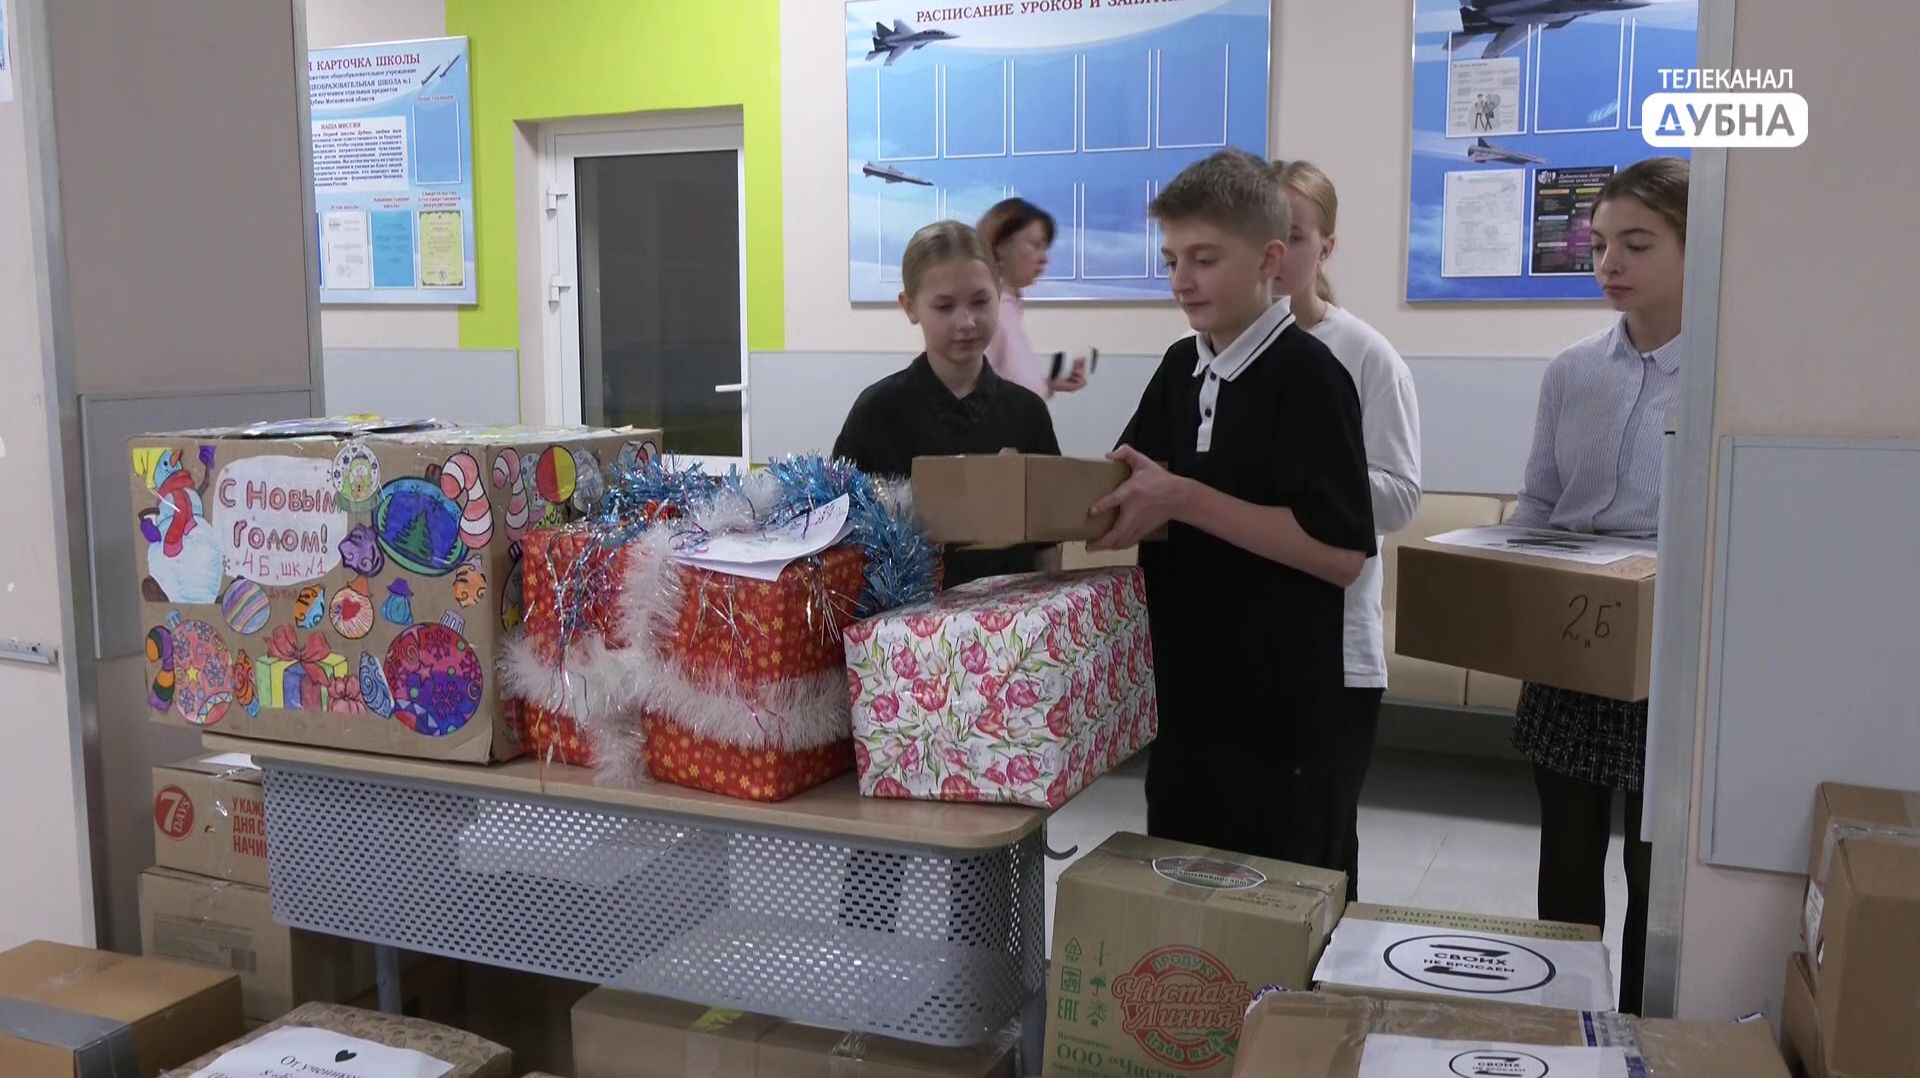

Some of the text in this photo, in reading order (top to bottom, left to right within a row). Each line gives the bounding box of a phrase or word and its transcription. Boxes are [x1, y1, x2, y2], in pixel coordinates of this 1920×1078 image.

[916, 3, 1014, 23] РАСПИСАНИЕ
[1020, 0, 1083, 14] УРОКОВ
[317, 57, 372, 71] КАРТОЧКА
[375, 53, 420, 67] ШКОЛЫ
[219, 478, 237, 508] С
[160, 791, 191, 833] 7 DAYS
[233, 815, 256, 835] ДНЯ
[1152, 953, 1220, 979] ПРОДУКТ
[1424, 958, 1515, 973] НЕ БРОСАЕМ
[1434, 952, 1507, 966] СВОИХ
[1112, 974, 1253, 1007] Чистая
[1122, 1001, 1246, 1034] Линия
[280, 1055, 301, 1068] От
[1057, 1043, 1103, 1067] ООО
